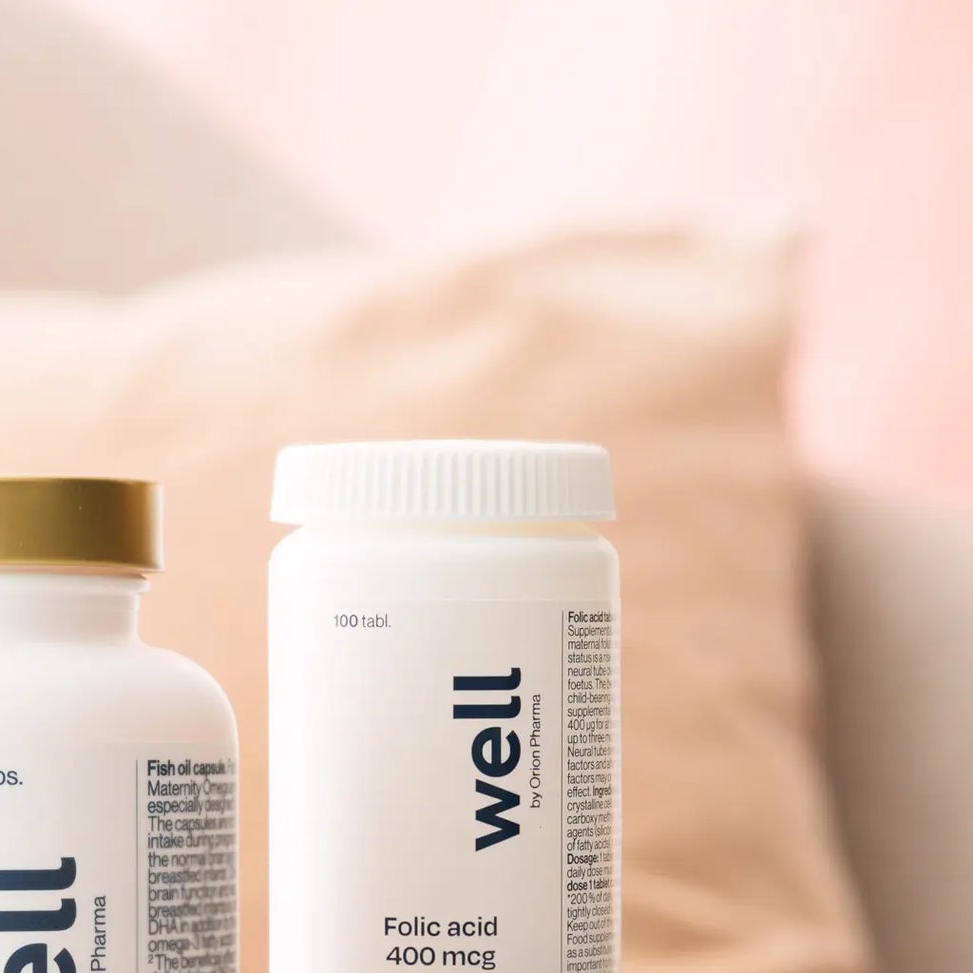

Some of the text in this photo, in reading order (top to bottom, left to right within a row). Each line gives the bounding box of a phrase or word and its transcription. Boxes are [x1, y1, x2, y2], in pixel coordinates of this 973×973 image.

[333, 612, 392, 629] 100 tabl.
[568, 610, 603, 623] Folic acid
[567, 639, 601, 651] maternal
[567, 652, 593, 664] status
[593, 652, 599, 664] is
[567, 665, 593, 677] neural
[567, 678, 595, 690] foetus.
[567, 719, 585, 731] 400
[567, 733, 579, 747] up
[580, 733, 588, 744] to
[589, 733, 605, 745] three
[529, 694, 543, 808] by Orion Pharma
[567, 746, 594, 758] Neural
[452, 667, 522, 852] well
[567, 759, 595, 771] factors
[147, 760, 175, 776] Fish
[178, 760, 191, 776] oil
[567, 773, 595, 785] factors
[147, 780, 201, 798] Maternity
[567, 786, 592, 799] effect.
[147, 798, 203, 815] especially
[567, 799, 604, 813] crystalline
[147, 815, 173, 832] The
[147, 833, 184, 849] intake
[567, 827, 594, 841] agents
[567, 839, 594, 853] of fatty
[147, 851, 170, 868] the
[567, 853, 600, 867] Dosage:
[567, 866, 586, 880] daily
[587, 866, 603, 878] dose
[148, 884, 178, 902] brain
[567, 880, 588, 892] dose
[589, 880, 593, 890] 1
[567, 906, 591, 921] tightly
[148, 918, 178, 935] DHA
[384, 916, 498, 937] Folic acid
[567, 920, 588, 932] Keep
[589, 919, 601, 931] out
[90, 896, 107, 972] Pharma
[567, 933, 588, 945] Food
[385, 946, 497, 971] 400 mcg
[567, 947, 584, 959] as a
[567, 959, 603, 973] important
